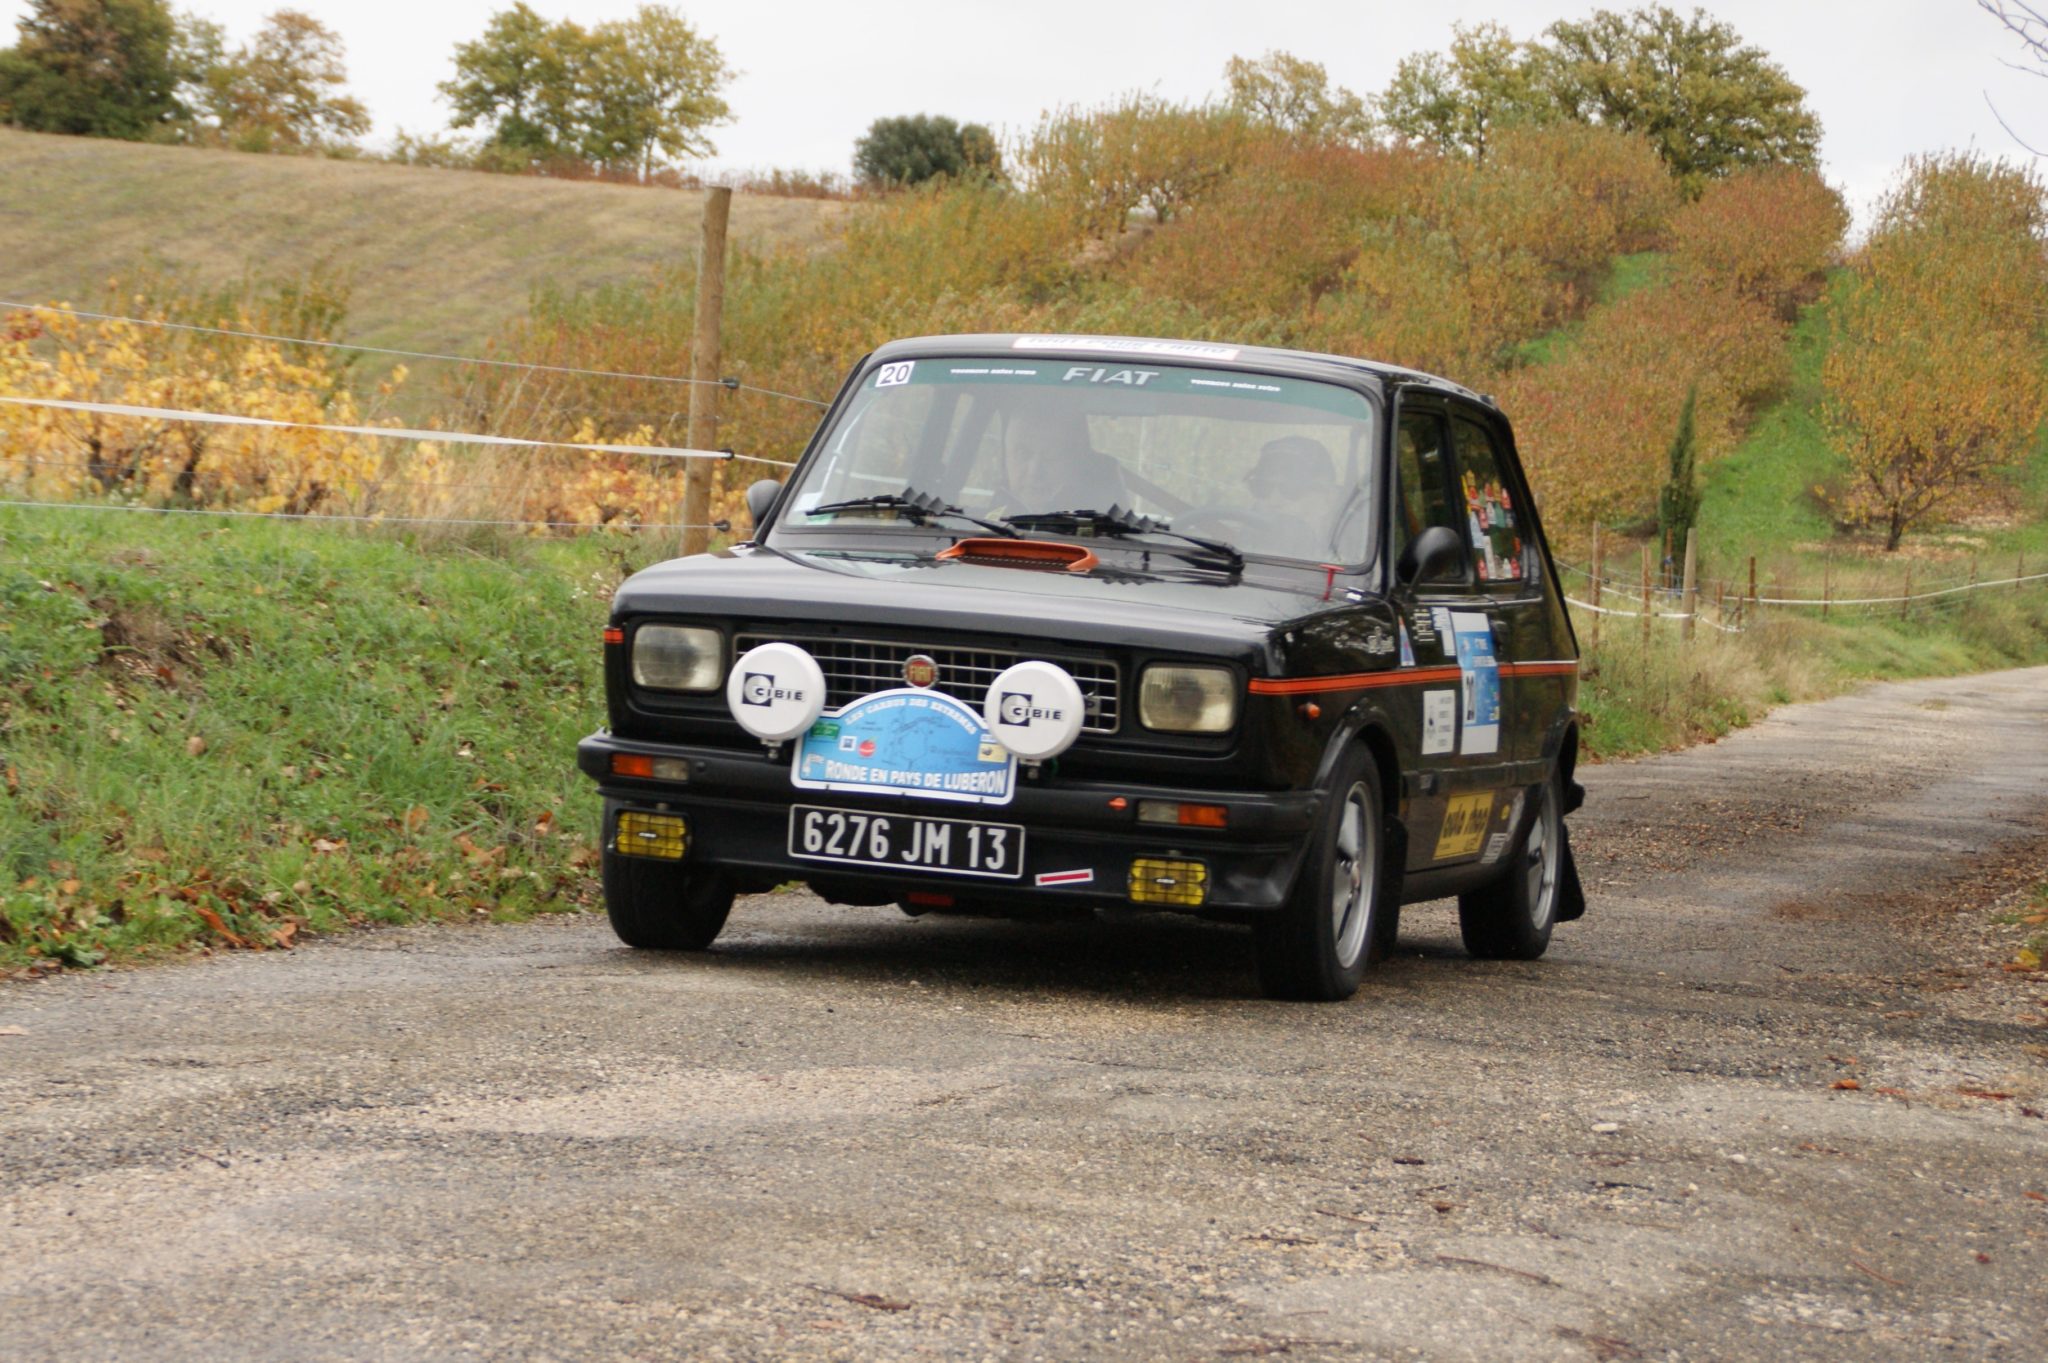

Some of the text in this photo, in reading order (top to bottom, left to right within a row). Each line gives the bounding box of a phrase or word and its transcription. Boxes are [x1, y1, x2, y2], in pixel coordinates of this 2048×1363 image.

[880, 364, 910, 384] 20
[1062, 367, 1160, 385] FIAT
[908, 665, 932, 682] FIAT
[755, 687, 803, 701] CIBIE
[1013, 707, 1062, 720] CIBIE
[825, 759, 867, 782] RONDE
[869, 767, 888, 783] EN
[890, 769, 922, 787] PAYS
[923, 773, 942, 787] DE
[944, 769, 1007, 794] LUBERON
[804, 811, 1006, 870] 6276 JM 13
